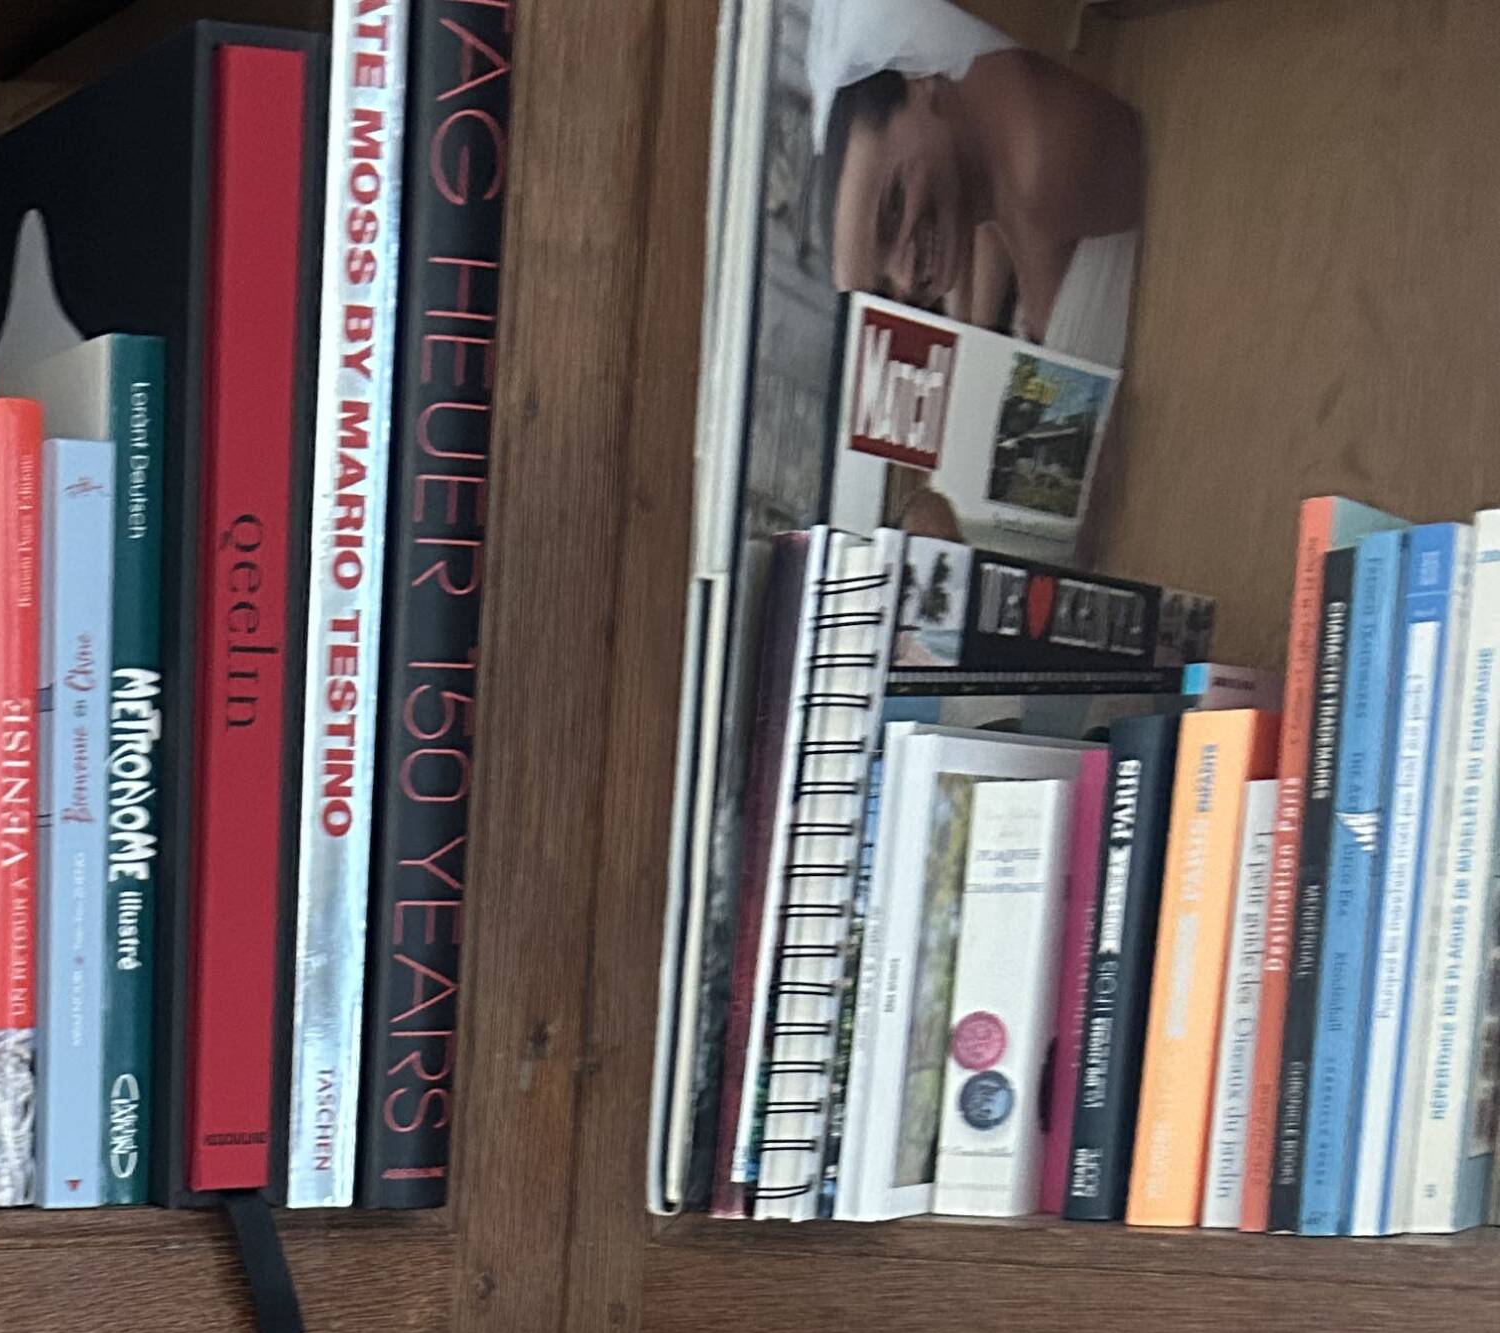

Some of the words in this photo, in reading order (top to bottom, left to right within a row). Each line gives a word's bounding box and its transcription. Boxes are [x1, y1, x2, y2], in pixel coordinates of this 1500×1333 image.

[346, 108, 388, 287] MOSS
[339, 305, 378, 381] BY
[411, 257, 500, 589] HEUER
[127, 454, 150, 540] Deutsch
[331, 399, 370, 591] MARIO
[61, 634, 97, 693] Chine
[1323, 601, 1348, 694] CHARACTER
[72, 699, 89, 718] en
[320, 609, 363, 838] TESTINO
[399, 647, 479, 805] 150
[1311, 697, 1339, 801] TRADEMARKS
[0, 698, 32, 869] VENISE
[59, 728, 95, 824] Bienvenue
[1109, 759, 1143, 841] PARIS
[1277, 777, 1304, 832] Paris
[8, 897, 29, 981] RETOUR
[1239, 911, 1268, 969] guide
[1263, 844, 1296, 972] Destination
[8, 987, 28, 1017] UN
[383, 835, 467, 1134] YEARS
[1237, 971, 1264, 1004] des
[313, 1065, 338, 1171] TASCHEN
[1223, 1104, 1247, 1133] du
[1214, 1139, 1242, 1199] jardin
